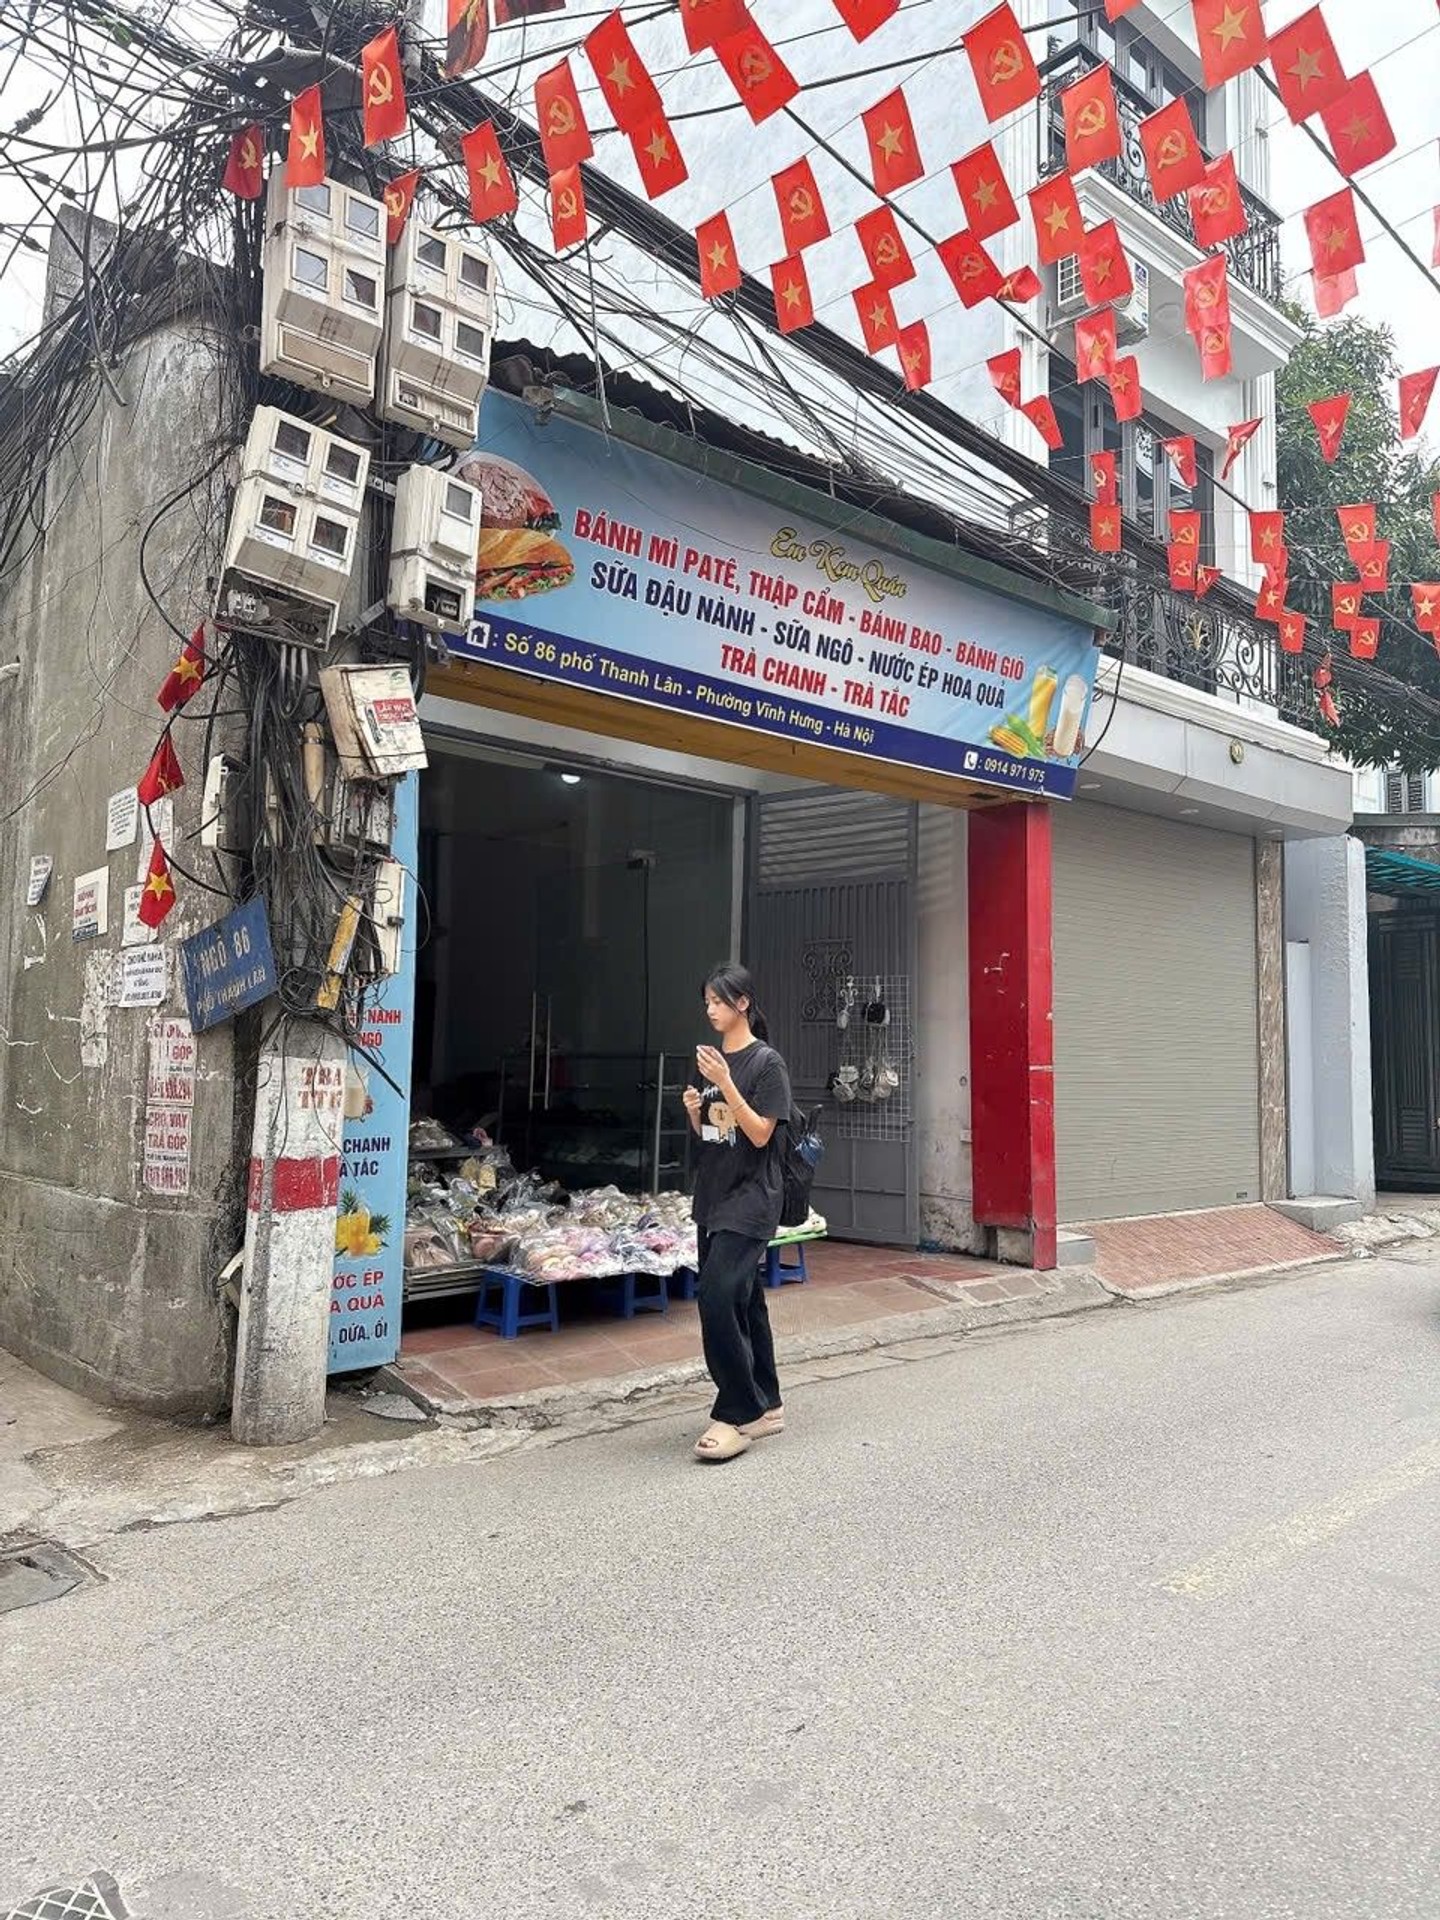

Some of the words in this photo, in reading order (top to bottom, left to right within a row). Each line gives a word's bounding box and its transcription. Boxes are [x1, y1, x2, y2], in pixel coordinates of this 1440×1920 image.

[574, 508, 643, 557] BÁNH
[648, 535, 678, 569] MÌ
[683, 547, 741, 594] PATÊ,
[749, 570, 798, 609] THẬP
[802, 586, 845, 625] CẨM
[860, 609, 907, 645] BÁNH
[910, 626, 942, 656] BAO
[956, 641, 997, 676] BÁNH
[591, 559, 638, 601] SỮA
[645, 578, 692, 617] ĐẬU
[696, 596, 756, 636] NÀNH
[773, 619, 811, 653] SỮA
[815, 633, 853, 665] NGÔ
[869, 650, 915, 683] NƯỚC
[917, 661, 938, 689] ÉP
[942, 673, 972, 701] HOA
[976, 680, 1005, 709] QUẢ
[504, 632, 533, 655] Số
[535, 641, 557, 662] 86
[560, 651, 596, 672] phố
[599, 658, 649, 687] Thanh
[653, 673, 683, 695] Lân
[696, 685, 751, 716] Phường
[756, 700, 786, 722] Vĩnh
[789, 709, 823, 735] Hưng
[834, 720, 850, 738] Hà
[853, 727, 875, 746] Nội
[721, 644, 756, 677] TRÀ
[763, 657, 827, 696] CHANH
[844, 680, 874, 709] TRÀ
[879, 687, 910, 717] TẮC
[984, 758, 1008, 775] 0914
[1010, 763, 1028, 780] 971
[1028, 767, 1045, 783] 975
[233, 926, 251, 959] 86
[169, 1113, 188, 1129] VAY
[343, 1136, 391, 1154] CHANH
[363, 1267, 384, 1287] ÉP
[347, 1288, 385, 1312] QUẢ
